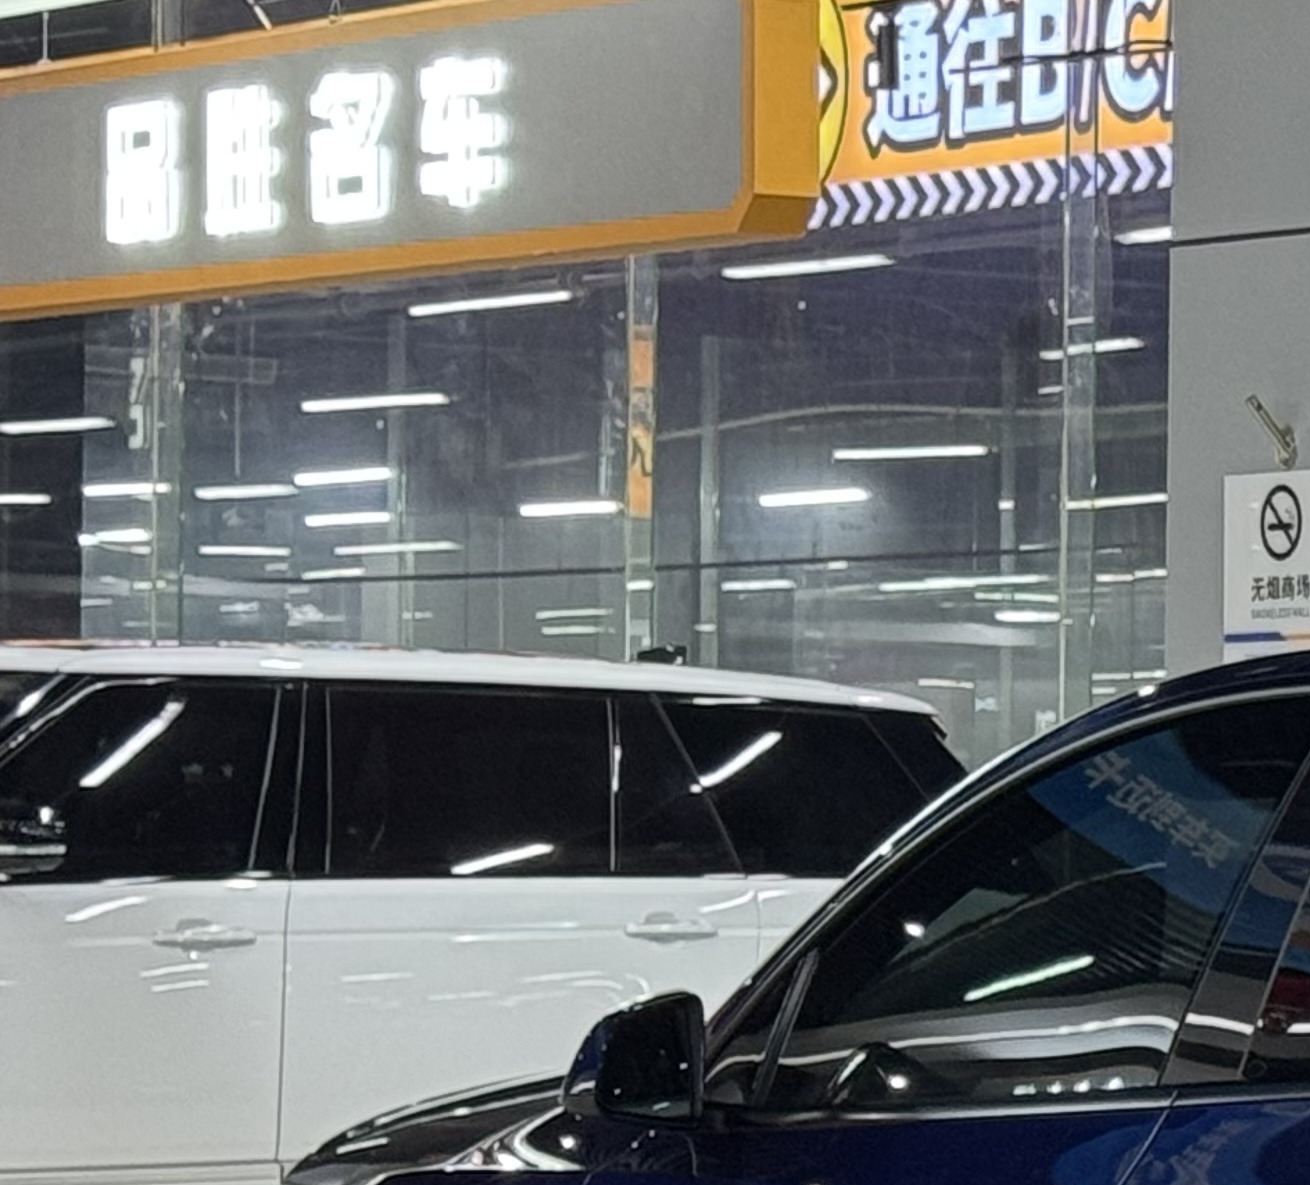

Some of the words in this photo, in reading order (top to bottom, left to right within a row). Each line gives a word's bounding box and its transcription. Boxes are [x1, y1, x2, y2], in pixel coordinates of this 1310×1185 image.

[865, 0, 1173, 149] 通往B/C
[105, 56, 507, 245] 品胜名车
[1250, 574, 1310, 602] 无烟商场
